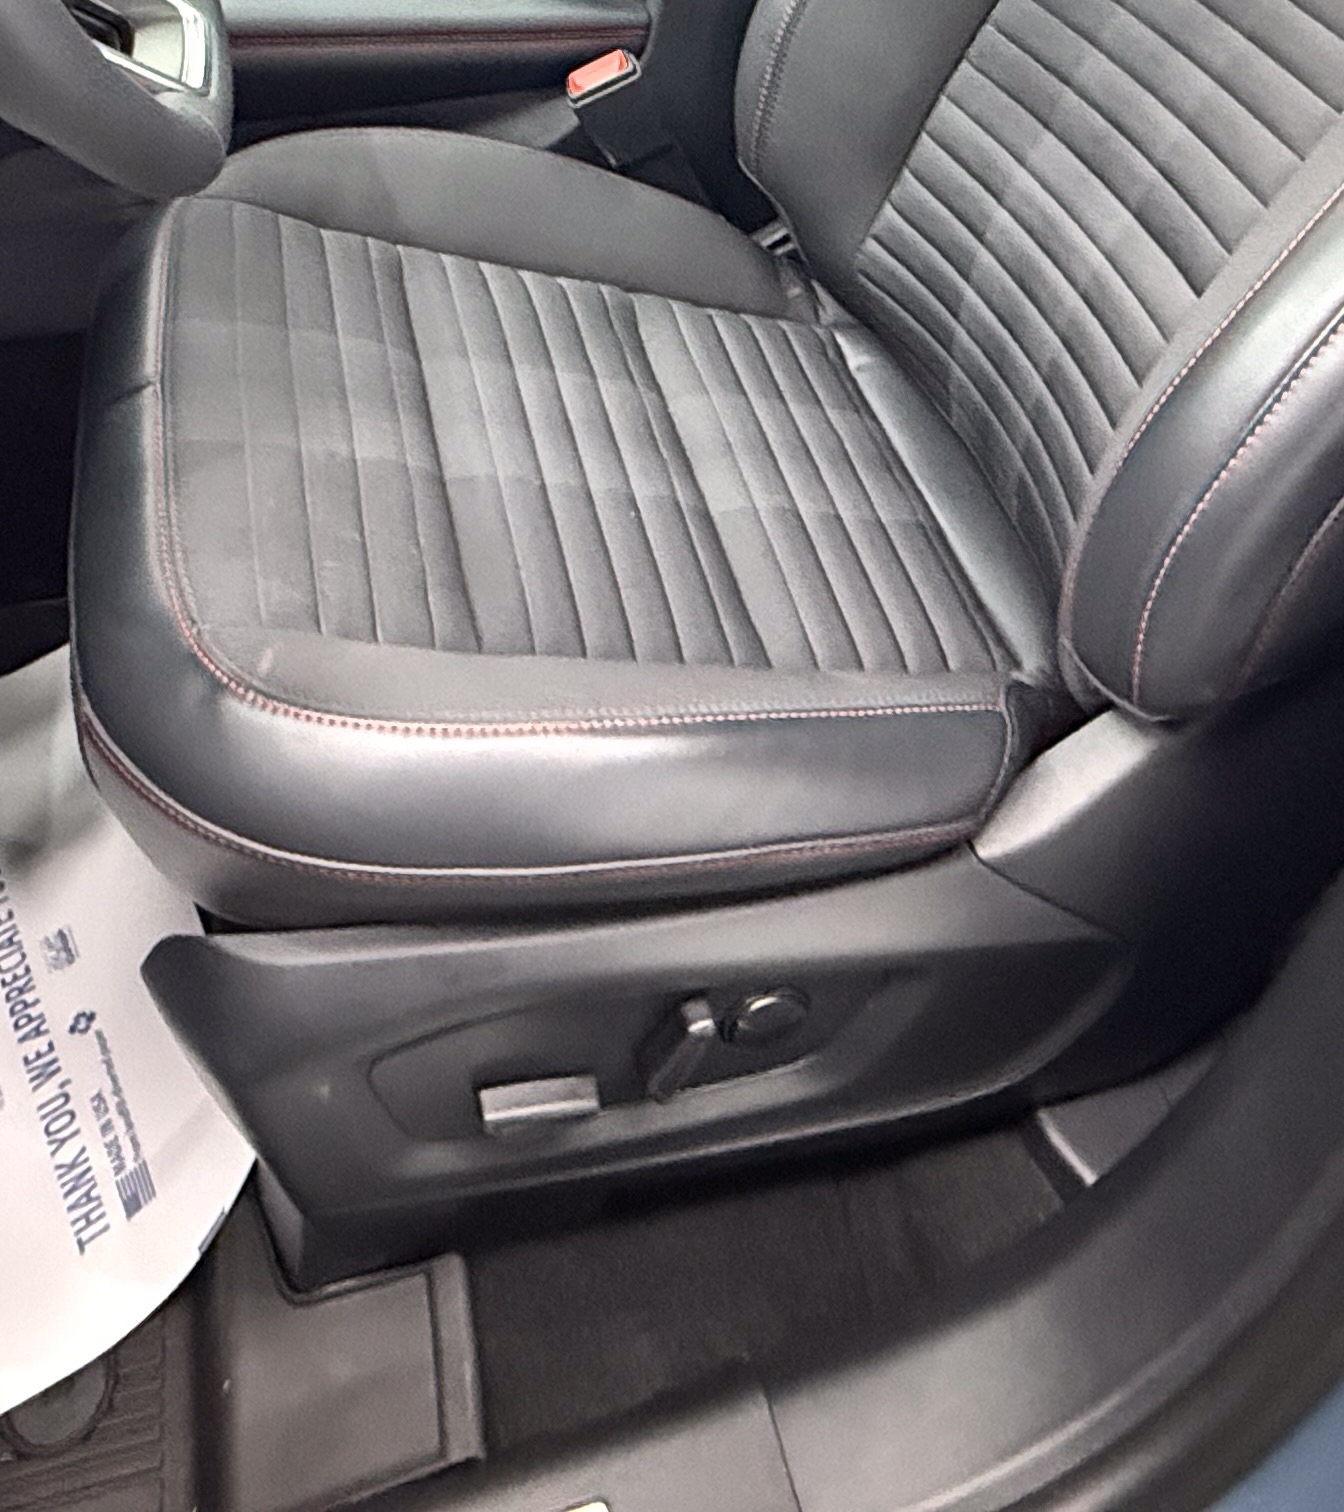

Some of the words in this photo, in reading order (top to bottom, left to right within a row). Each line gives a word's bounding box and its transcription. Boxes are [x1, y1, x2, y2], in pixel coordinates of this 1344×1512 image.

[23, 1040, 62, 1092] WE
[37, 1079, 81, 1160] YOU,
[54, 1145, 111, 1256] THANK
